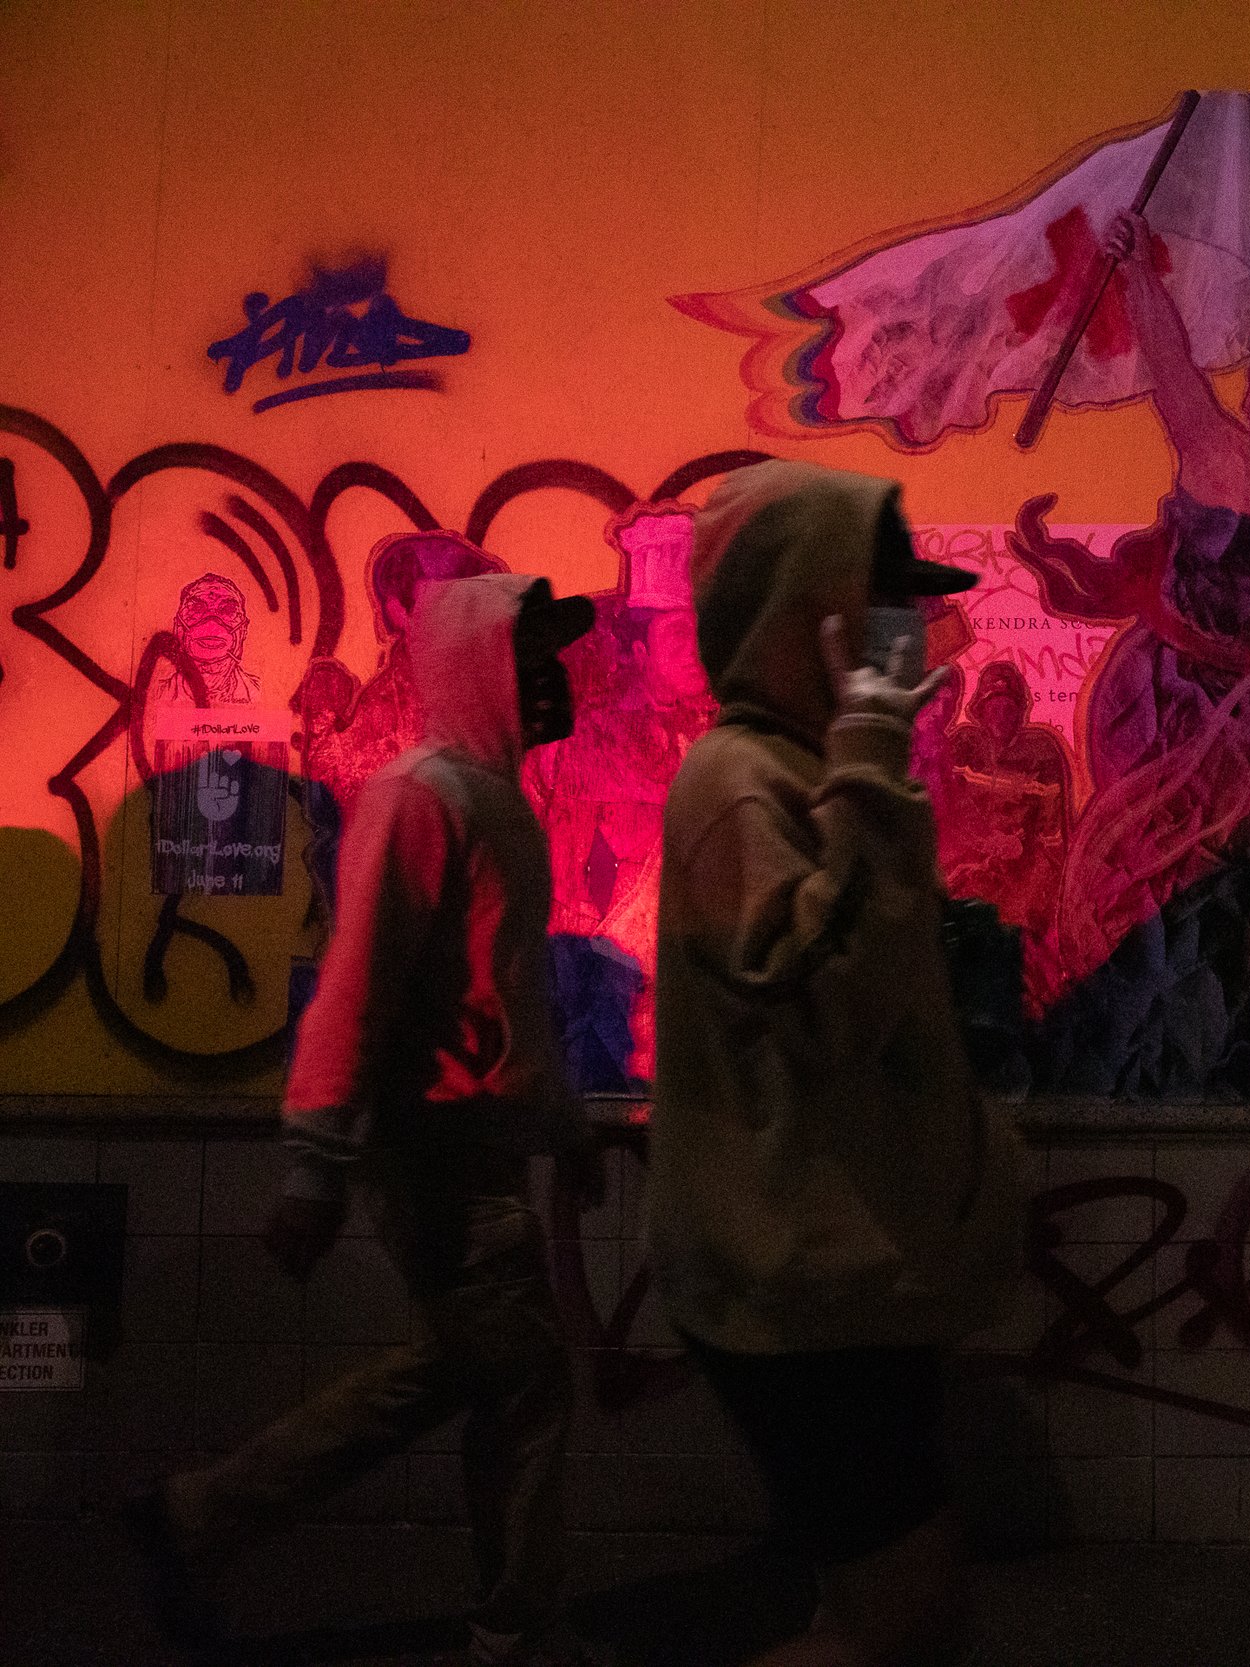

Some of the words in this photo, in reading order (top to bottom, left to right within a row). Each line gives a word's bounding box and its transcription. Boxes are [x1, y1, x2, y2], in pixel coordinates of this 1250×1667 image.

[972, 617, 1051, 630] KENDRA
[187, 868, 226, 889] June
[231, 873, 244, 891] 11
[0, 1343, 77, 1358] ARTMENT
